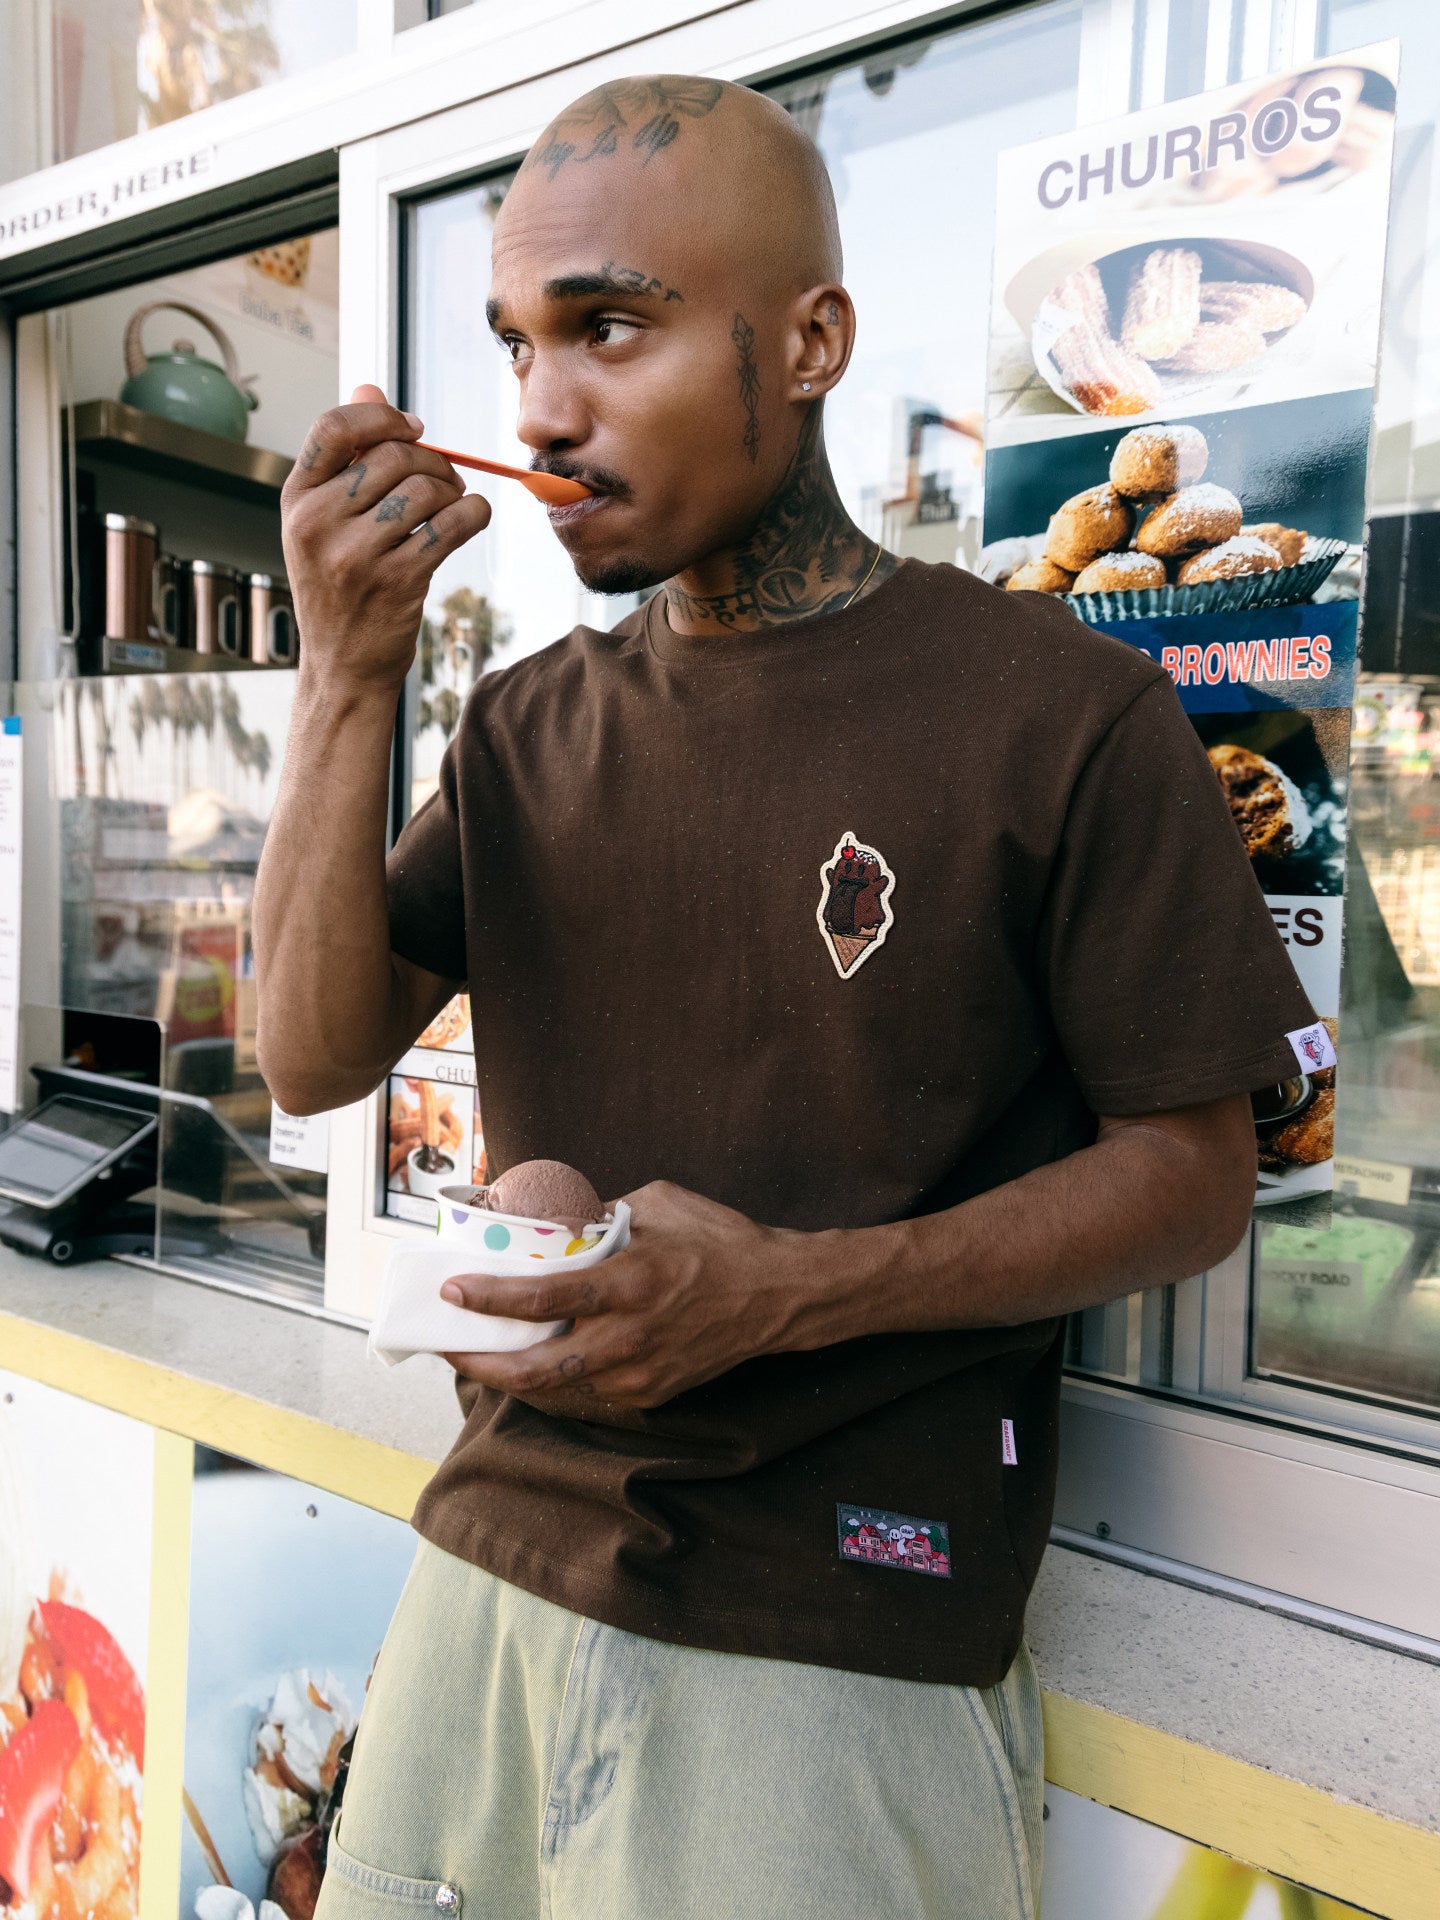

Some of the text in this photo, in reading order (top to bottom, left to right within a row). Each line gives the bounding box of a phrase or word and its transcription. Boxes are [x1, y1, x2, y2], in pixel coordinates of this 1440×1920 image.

[1037, 86, 1342, 210] CHURROS
[1161, 635, 1332, 686] BROWNIES
[435, 1065, 477, 1084] CHU
[1310, 1271, 1351, 1286] ROAD
